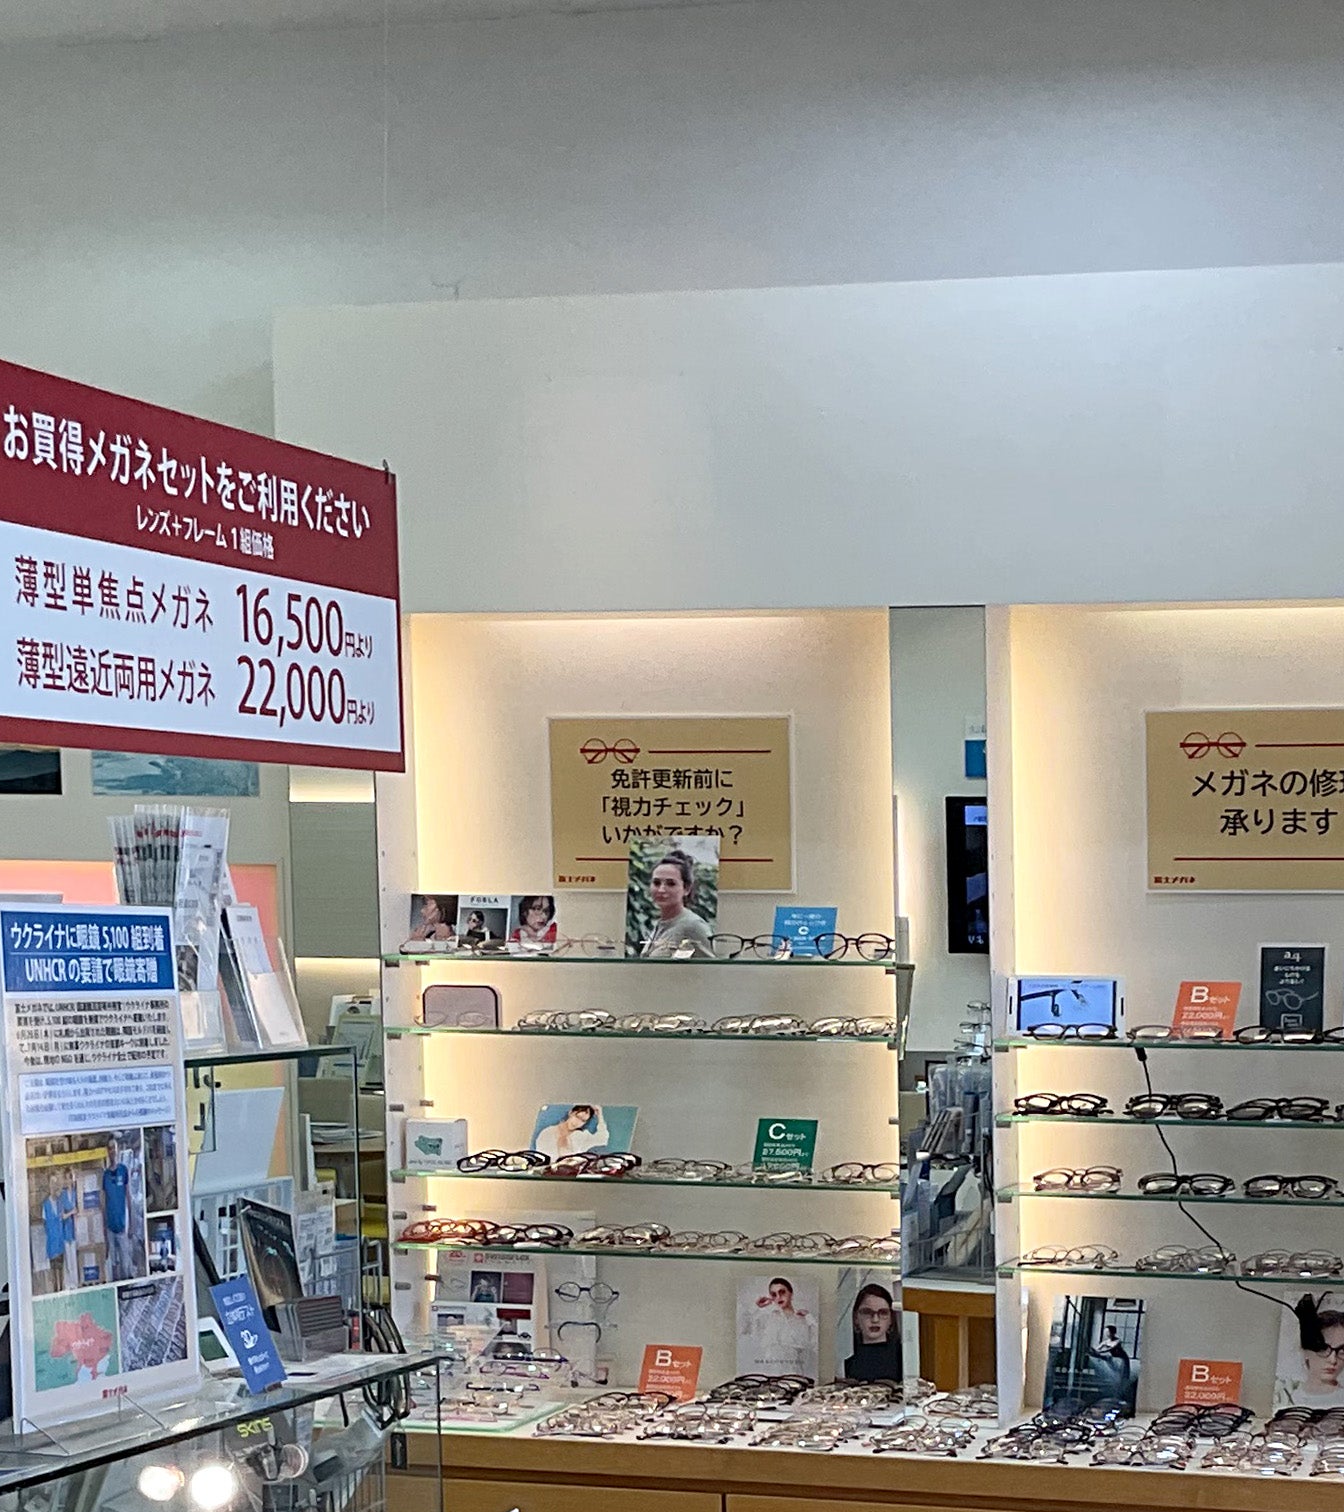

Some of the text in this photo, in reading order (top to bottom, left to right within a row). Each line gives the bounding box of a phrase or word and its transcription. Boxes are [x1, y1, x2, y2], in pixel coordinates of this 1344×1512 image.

[2, 404, 371, 539] お買得メガネセットをご利用ください
[14, 555, 214, 634] 薄型単焦点メガネ
[236, 583, 374, 659] 16,500円より
[16, 637, 216, 708] 薄型遠近両用メガネ
[237, 655, 376, 728] 22,000円より
[600, 796, 746, 818] 「視力チェック」
[611, 767, 733, 791] 免許更新前に
[1220, 808, 1339, 837] 承ります
